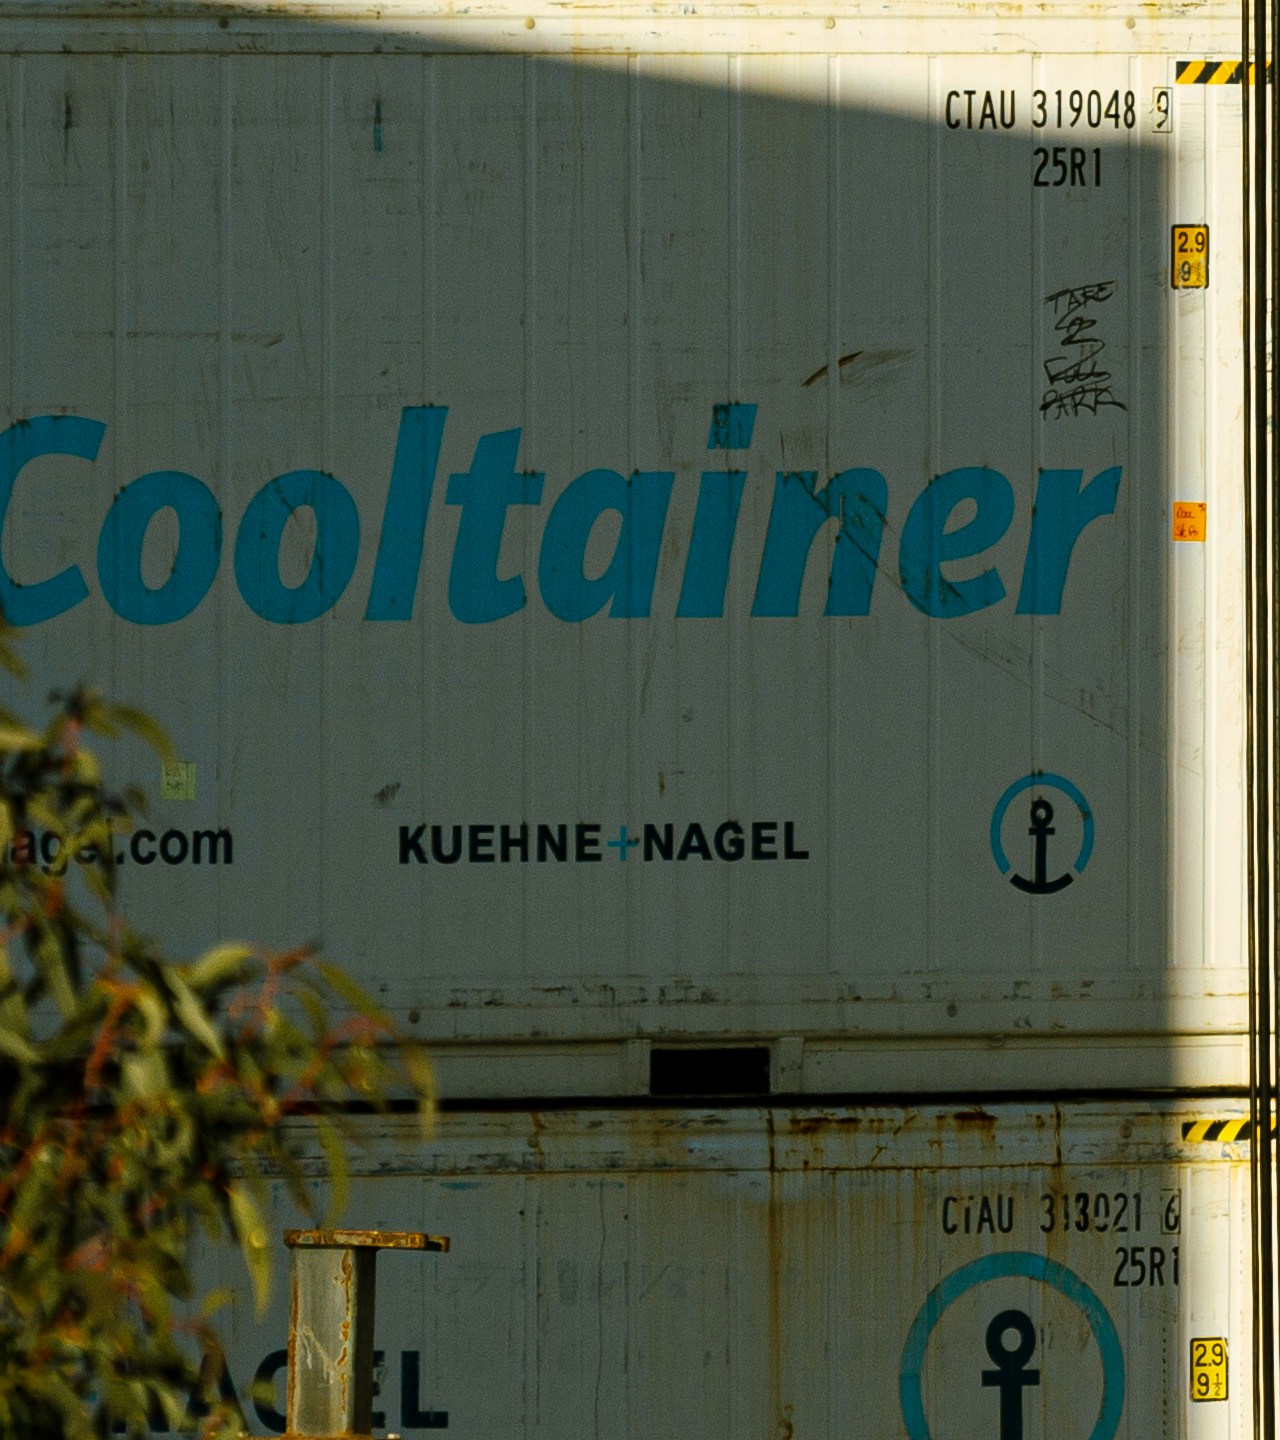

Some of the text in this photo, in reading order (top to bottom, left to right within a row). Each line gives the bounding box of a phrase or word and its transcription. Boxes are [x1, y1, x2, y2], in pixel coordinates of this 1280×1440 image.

[945, 90, 1016, 130] CTAU
[1032, 89, 1137, 130] 319048
[1033, 147, 1102, 188] 25R1
[1177, 231, 1206, 254] 2.9
[0, 402, 1123, 626] Cooltainer
[941, 1195, 1014, 1235] CTAU
[1112, 1246, 1180, 1288] 25R1
[1194, 1342, 1225, 1368] 2.9
